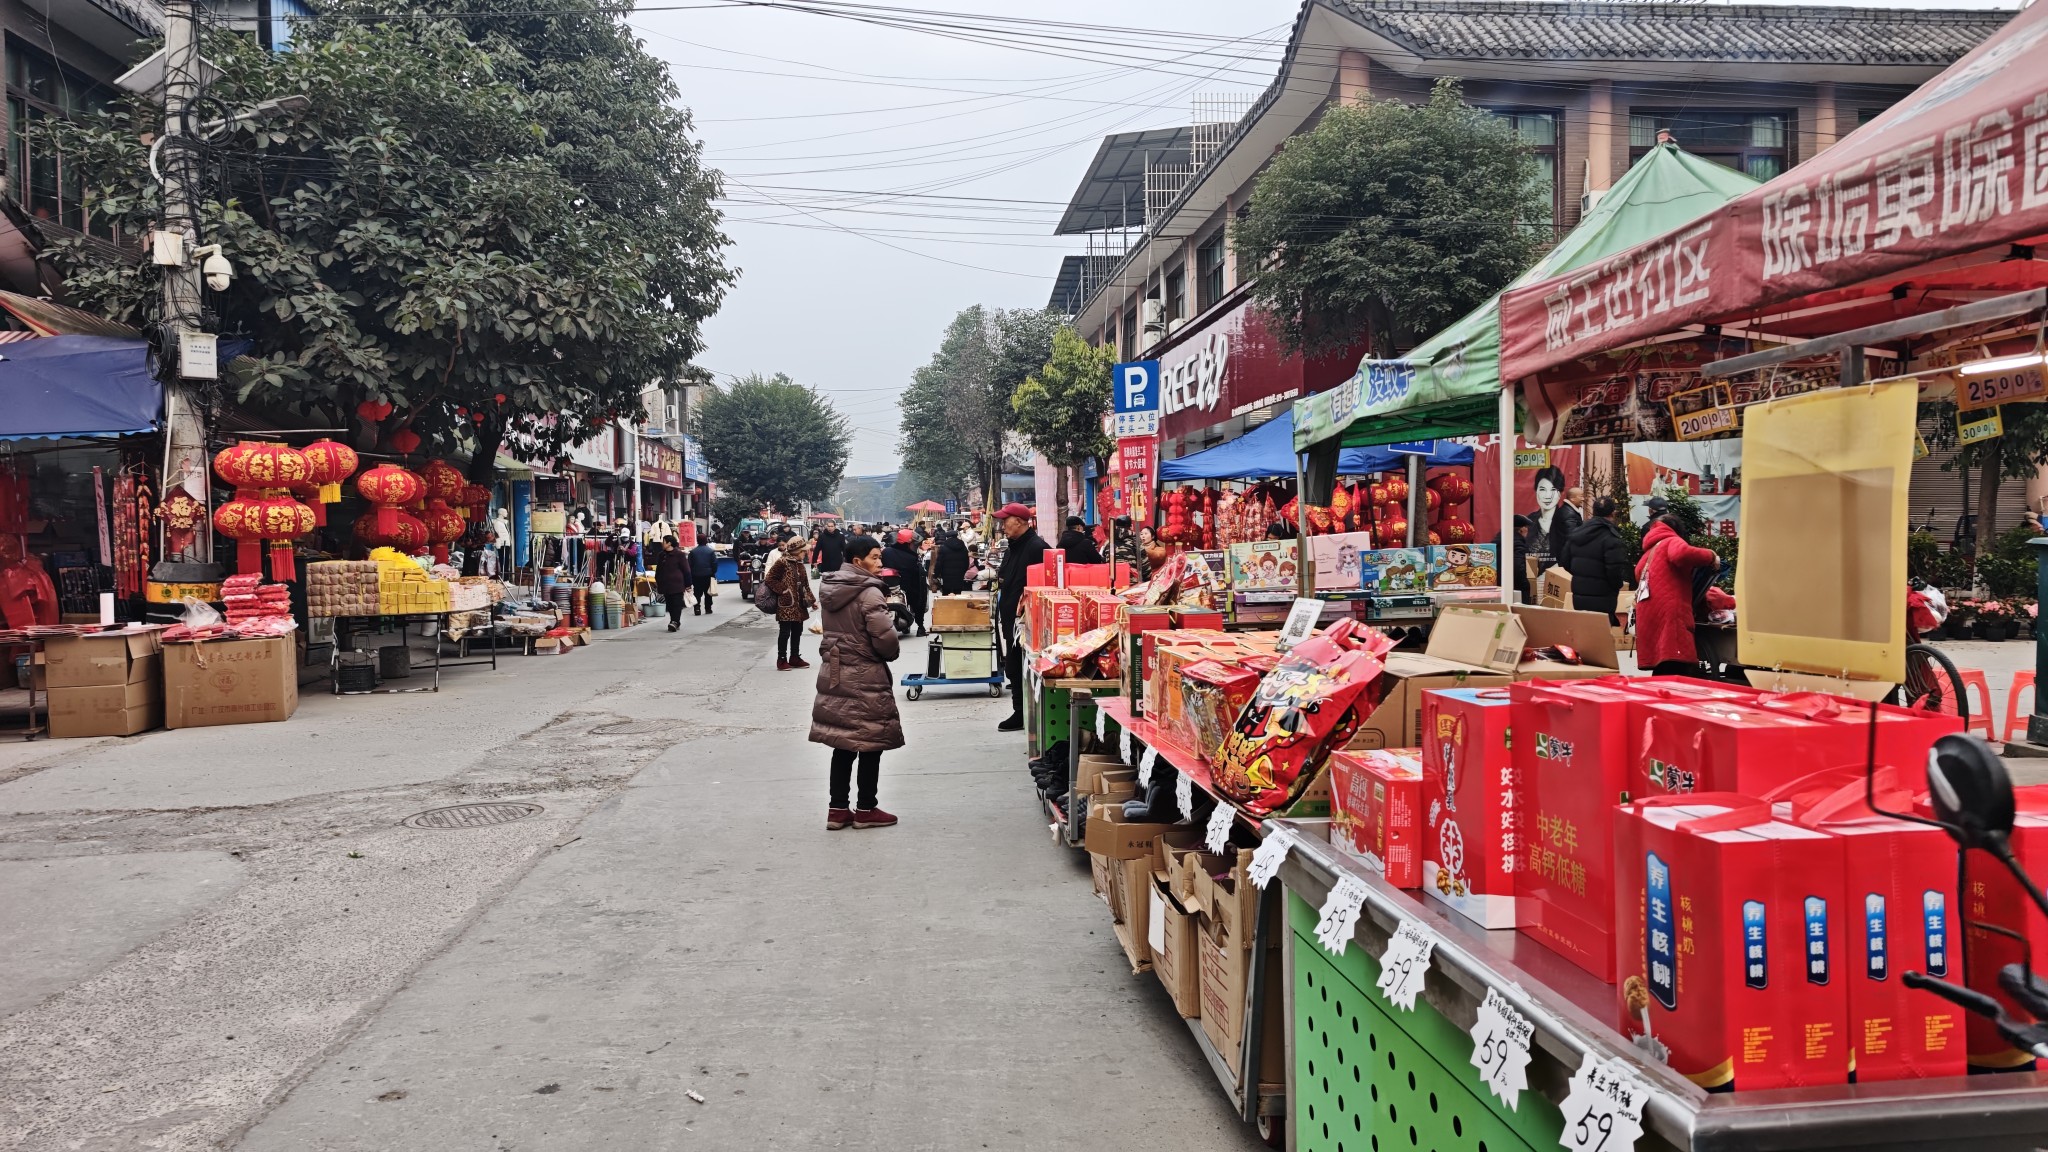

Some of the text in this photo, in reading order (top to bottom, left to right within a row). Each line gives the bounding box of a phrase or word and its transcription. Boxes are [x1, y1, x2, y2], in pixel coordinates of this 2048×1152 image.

[1543, 220, 1713, 352] 威王进社区
[1124, 366, 1149, 409] P
[1368, 361, 1415, 404] 没蚊子
[1118, 412, 1156, 424] 停车入位
[1118, 423, 1156, 434] 车头一致
[1547, 582, 1561, 598] 勿压
[1549, 736, 1574, 768] 蒙牛
[1351, 771, 1369, 800] 高钙
[1666, 764, 1695, 794] 蒙牛
[1536, 808, 1579, 855] 中老年
[1528, 842, 1587, 899] 高钙低糖
[1322, 905, 1347, 941] 59
[1649, 865, 1671, 990] 养生核桃
[1679, 894, 1695, 956] 核桃奶
[1747, 907, 1764, 978] 养生核桃
[1808, 903, 1825, 975] 养生核桃
[1870, 900, 1884, 971] 养生核桃
[1927, 897, 1943, 967] 养生核桃
[1384, 953, 1412, 995] 59
[1480, 1029, 1508, 1079] 59
[1586, 1066, 1634, 1109] 养生核桃
[1575, 1104, 1613, 1152] 59
